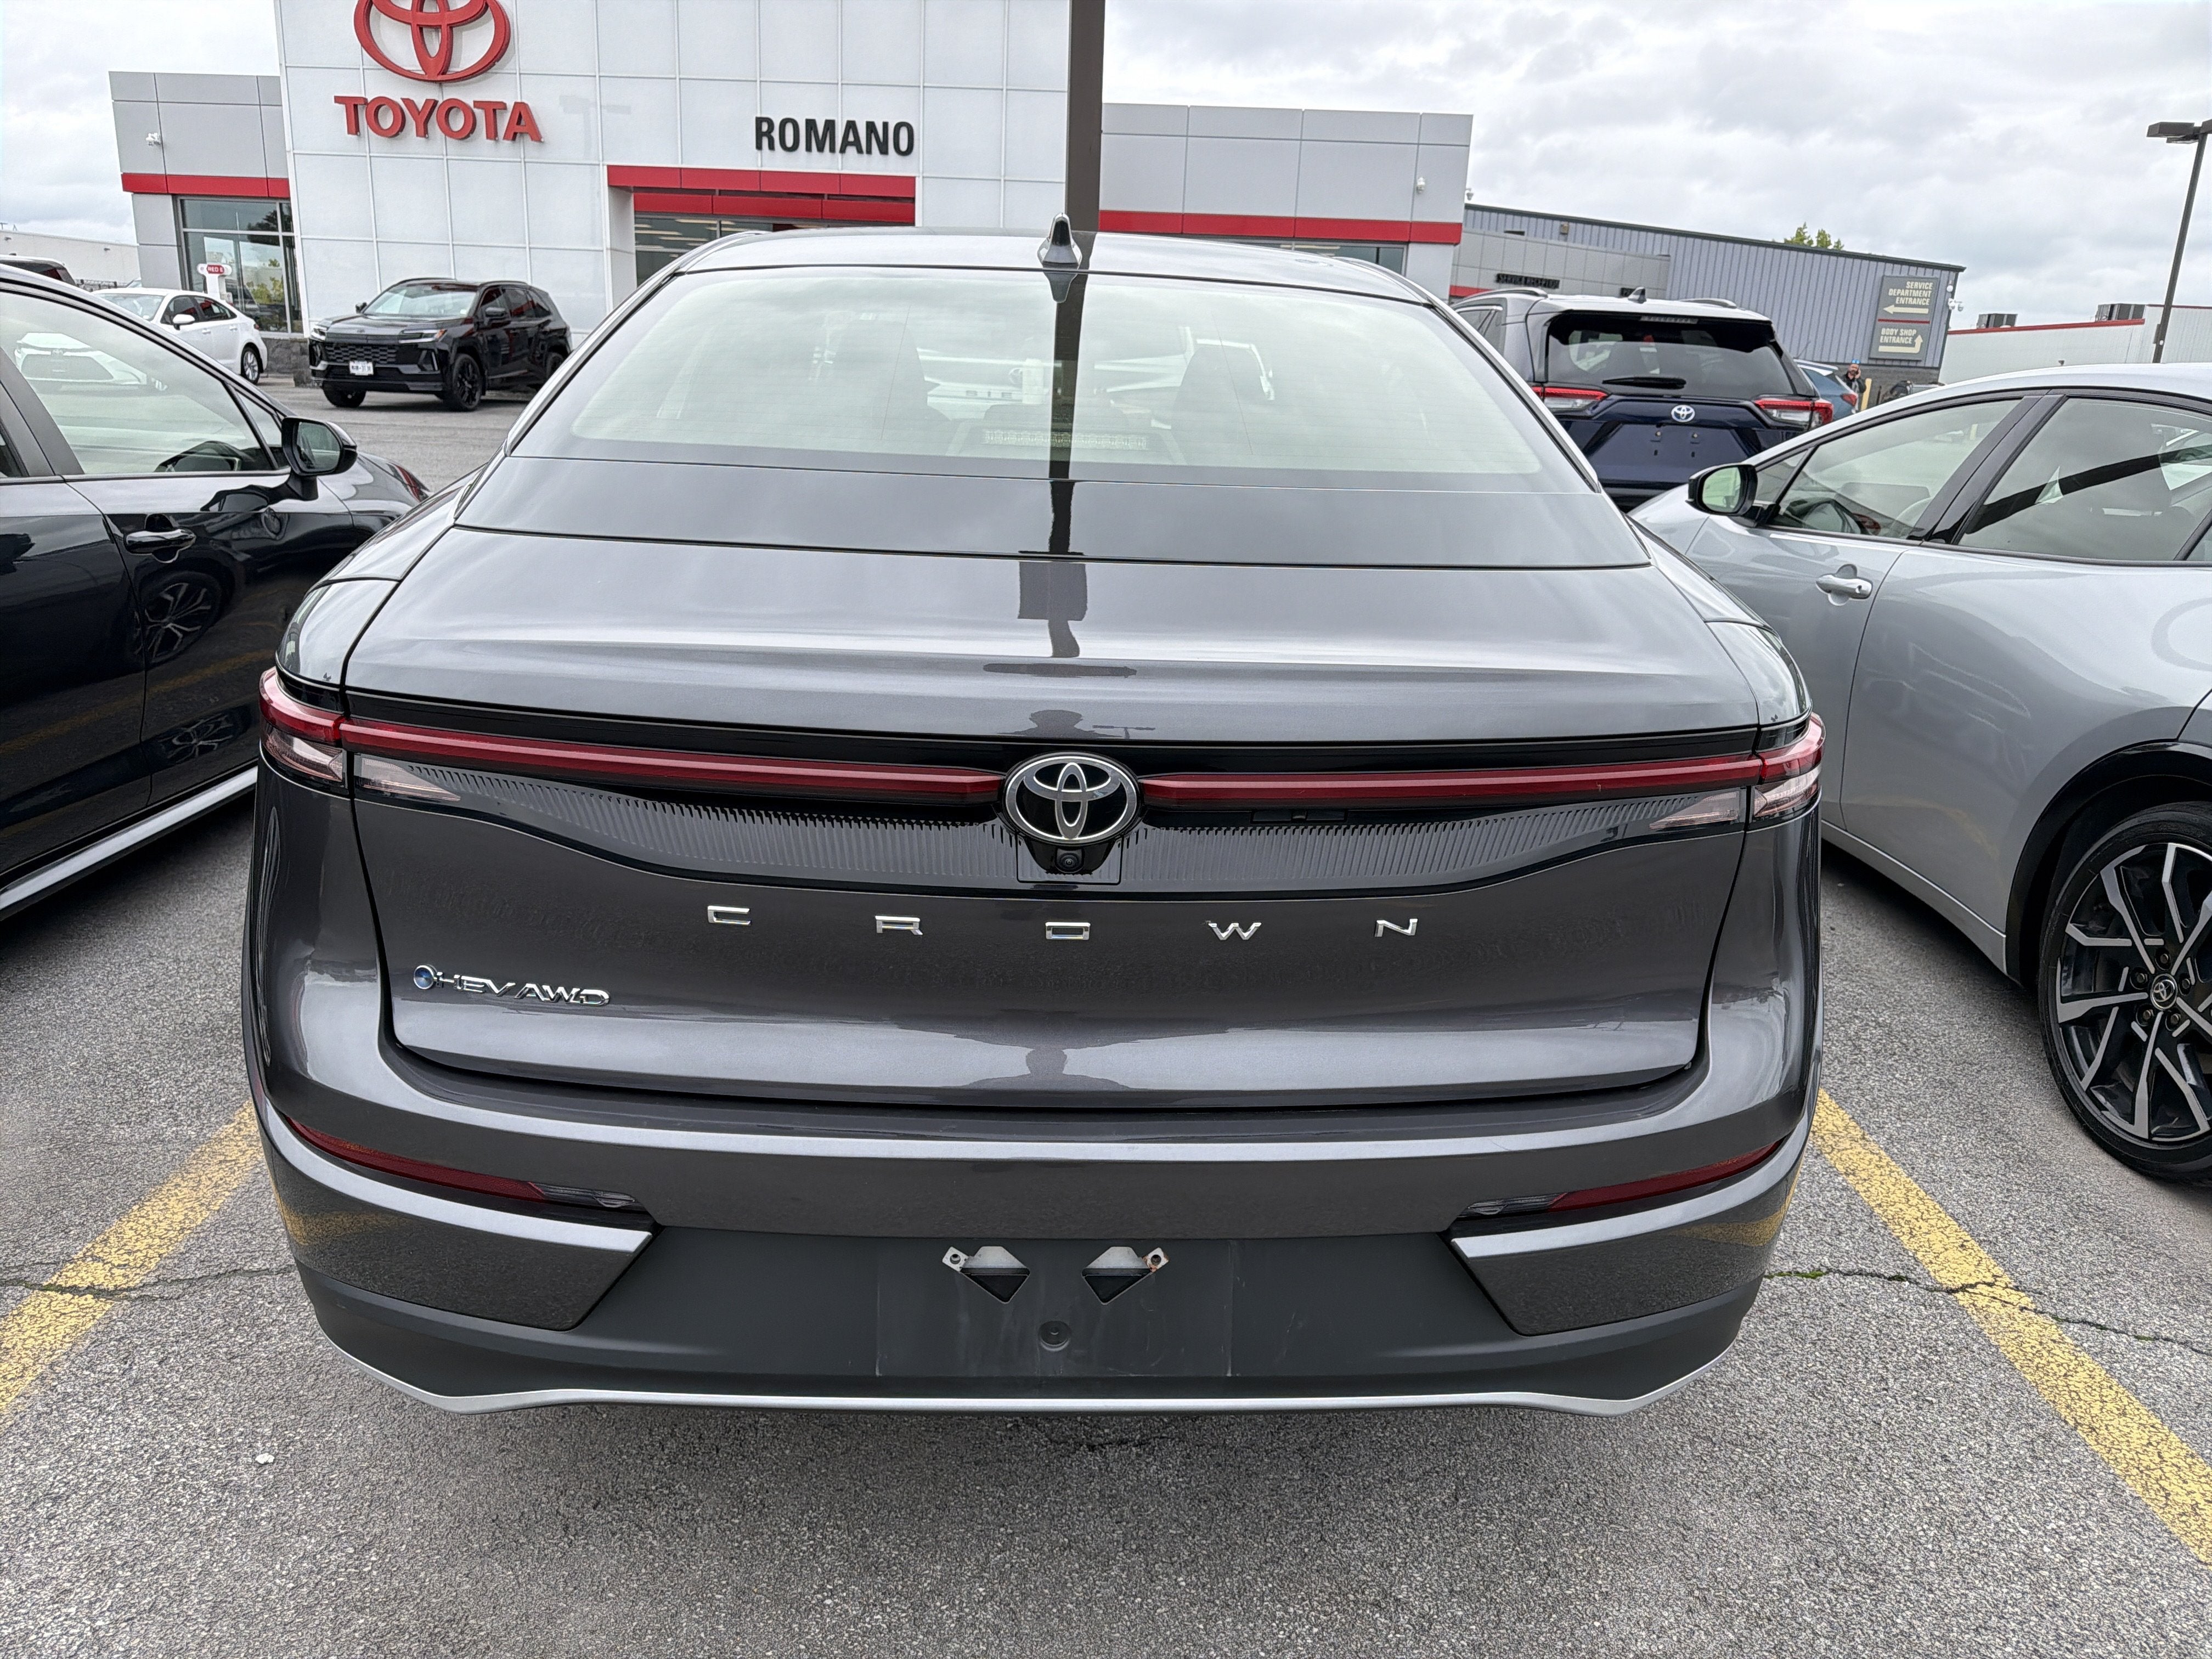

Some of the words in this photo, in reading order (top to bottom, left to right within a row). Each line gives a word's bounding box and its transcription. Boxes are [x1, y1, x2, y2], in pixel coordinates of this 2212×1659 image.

[334, 95, 543, 143] TOYOTA
[755, 116, 915, 157] ROMANO
[1906, 281, 1934, 290] SERVICE
[1888, 288, 1932, 298] DEPARTMENT
[1895, 297, 1931, 306] ENTRANCE
[1881, 328, 1898, 336] BODY
[1899, 328, 1917, 336] SHOP
[1880, 336, 1912, 344] ENTRANCE
[707, 905, 1418, 941] CROWN
[513, 983, 611, 1006] AWD
